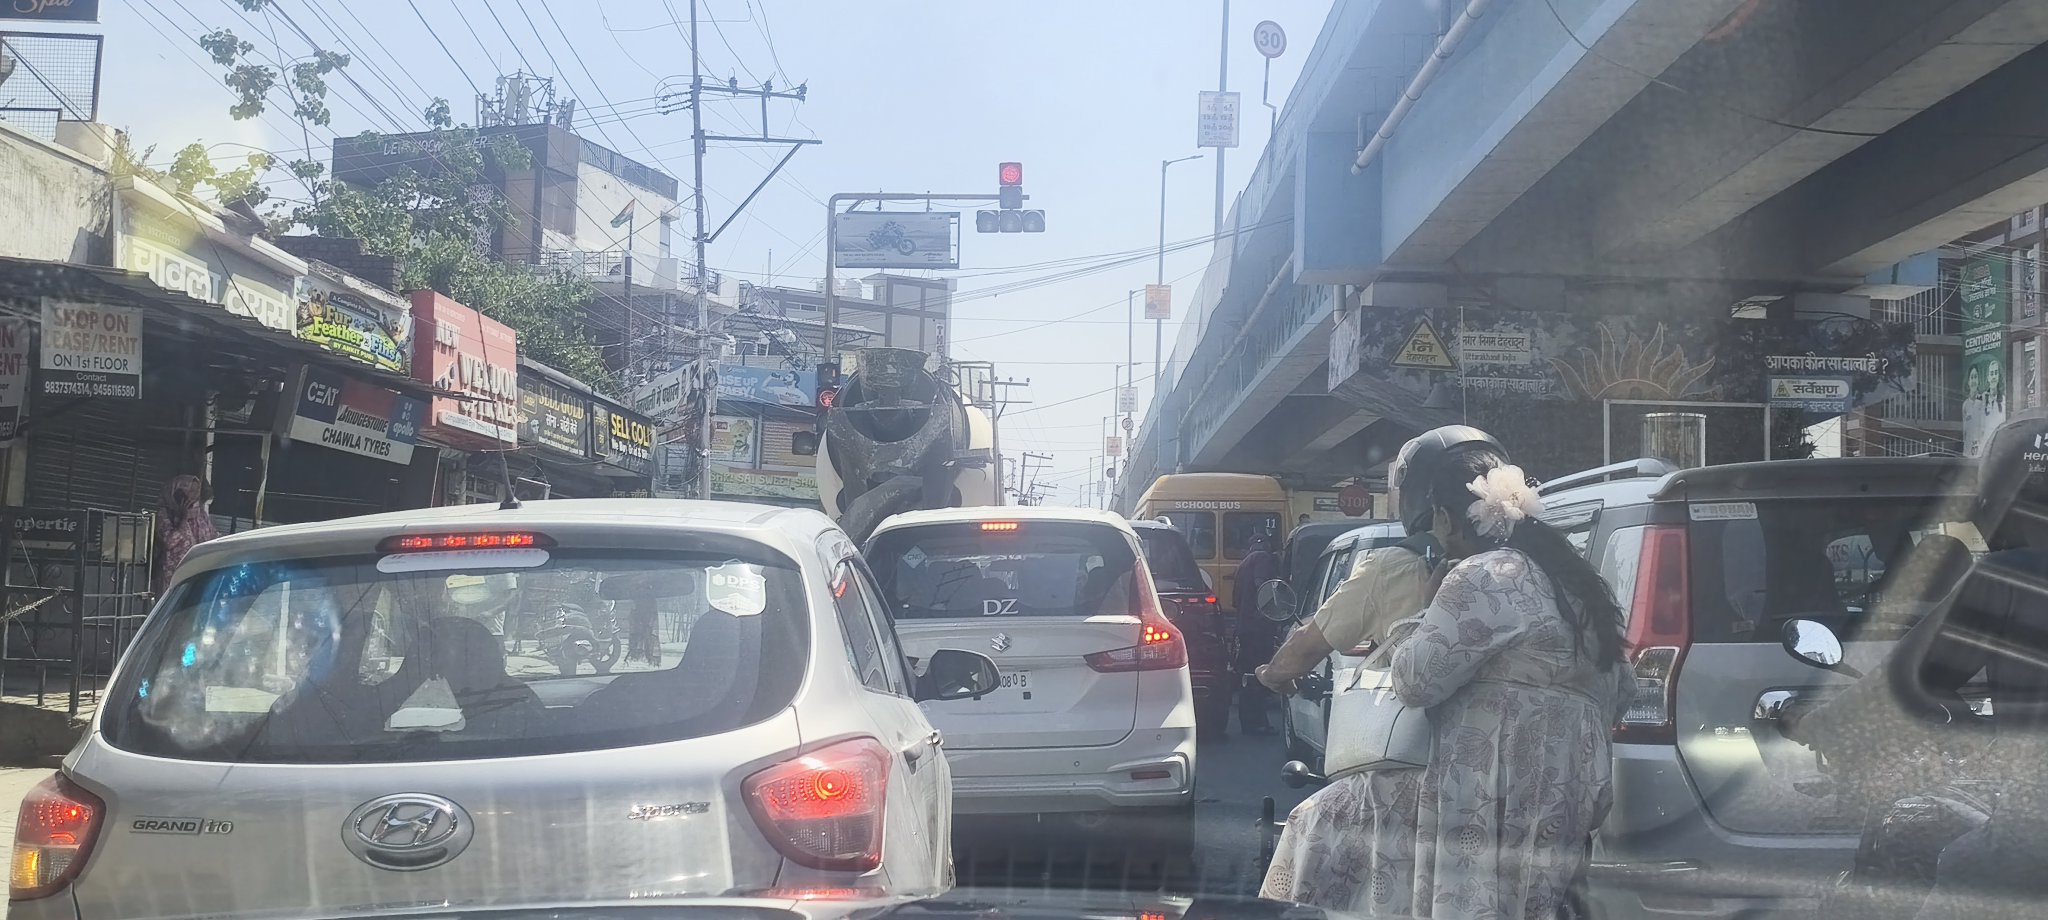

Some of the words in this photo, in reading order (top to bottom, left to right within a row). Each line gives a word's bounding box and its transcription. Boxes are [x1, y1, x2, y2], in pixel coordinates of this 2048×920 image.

[1260, 30, 1280, 48] 30
[54, 307, 98, 329] SHOP
[103, 313, 128, 333] ON
[326, 305, 352, 327] Fur
[313, 316, 363, 346] Feather
[370, 335, 396, 361] Fins
[435, 319, 460, 350] NEW
[1965, 331, 2001, 348] CENTURION
[53, 353, 72, 367] ON
[76, 355, 90, 369] 1st
[94, 357, 128, 371] FLOOR
[76, 372, 106, 382] Contact
[742, 377, 758, 387] UP
[307, 381, 339, 406] CEAT
[1792, 381, 1839, 395] सर्वेक्षण
[539, 383, 560, 411] SELL
[561, 393, 584, 419] GOLD
[337, 407, 389, 433] BRIDGESTONE
[611, 413, 630, 440] SELL
[393, 421, 414, 437] apollo
[322, 428, 360, 450] CHAWLA
[364, 437, 391, 457] TYRES
[759, 475, 791, 487] SWEET
[1175, 501, 1218, 510] SCHOOL
[1219, 501, 1241, 510] BUS
[1340, 495, 1369, 508] STOP
[1265, 518, 1277, 529] 11
[982, 599, 1019, 615] DZ
[1021, 675, 1027, 687] B
[133, 820, 197, 832] GRAND
[204, 819, 233, 834] i10
